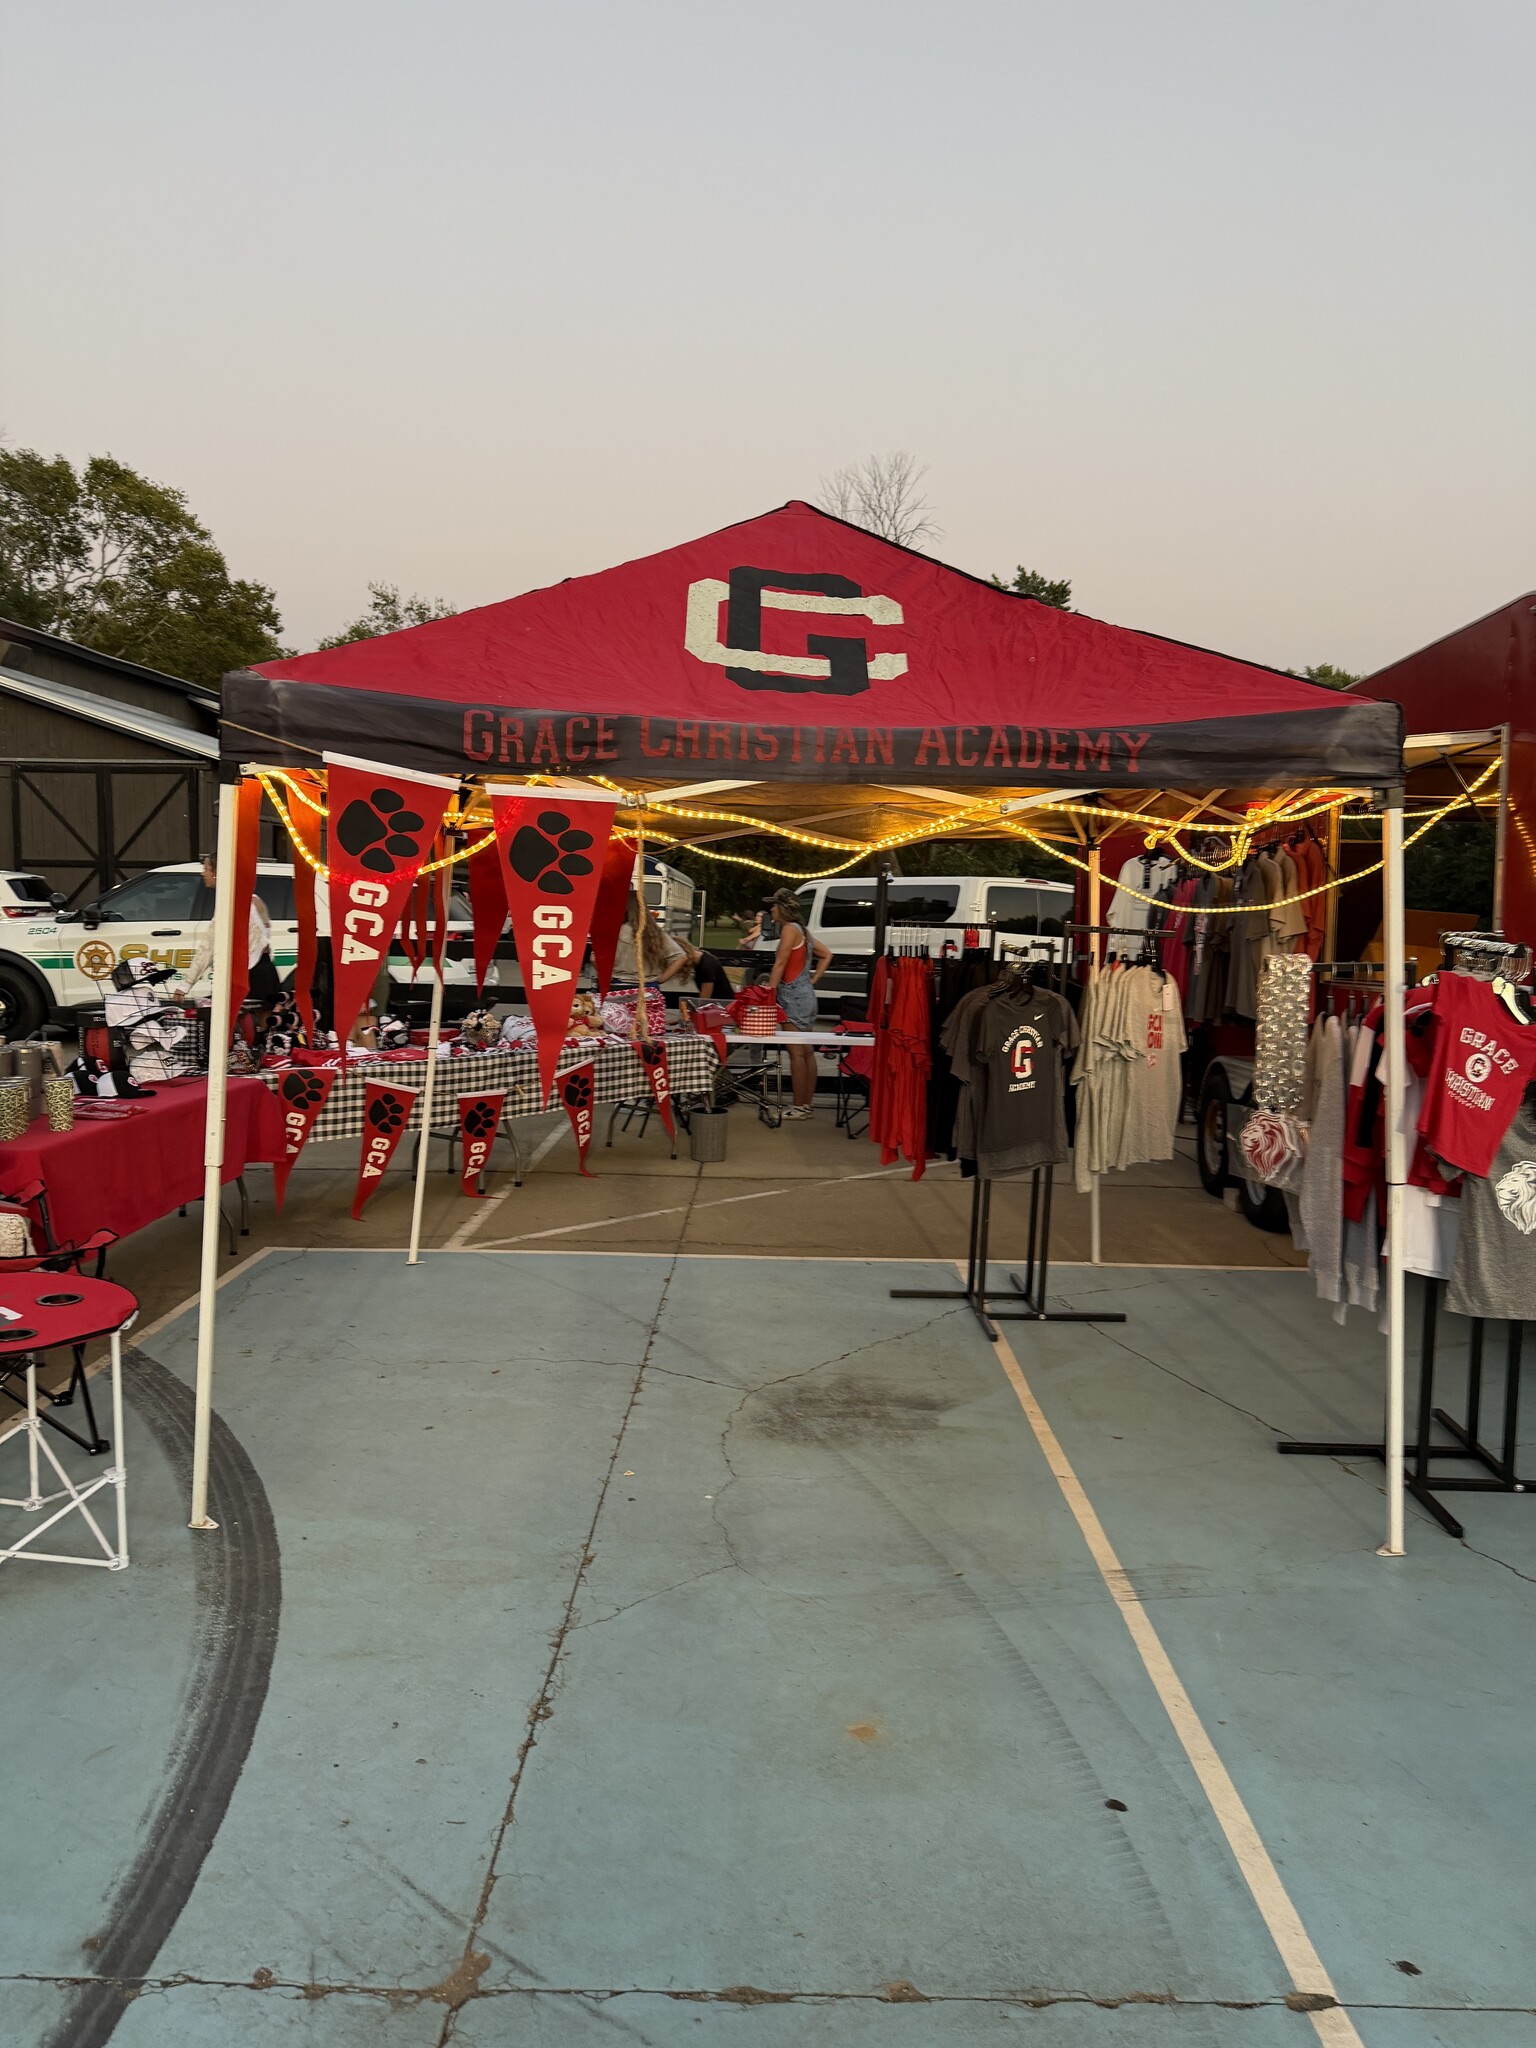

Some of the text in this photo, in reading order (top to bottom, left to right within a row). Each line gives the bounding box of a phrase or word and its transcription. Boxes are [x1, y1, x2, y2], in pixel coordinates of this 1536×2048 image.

[463, 709, 1151, 773] GRACE CHRISTIAN ACADEMY
[27, 926, 58, 935] 2504
[341, 880, 389, 965] GCA
[532, 905, 573, 990] GCA
[1460, 1027, 1519, 1075] GRACE
[653, 1067, 668, 1103] GCA
[285, 1111, 307, 1154] GCA
[577, 1109, 591, 1147] GCA
[362, 1137, 391, 1178] GCA
[463, 1141, 487, 1179] GCA
